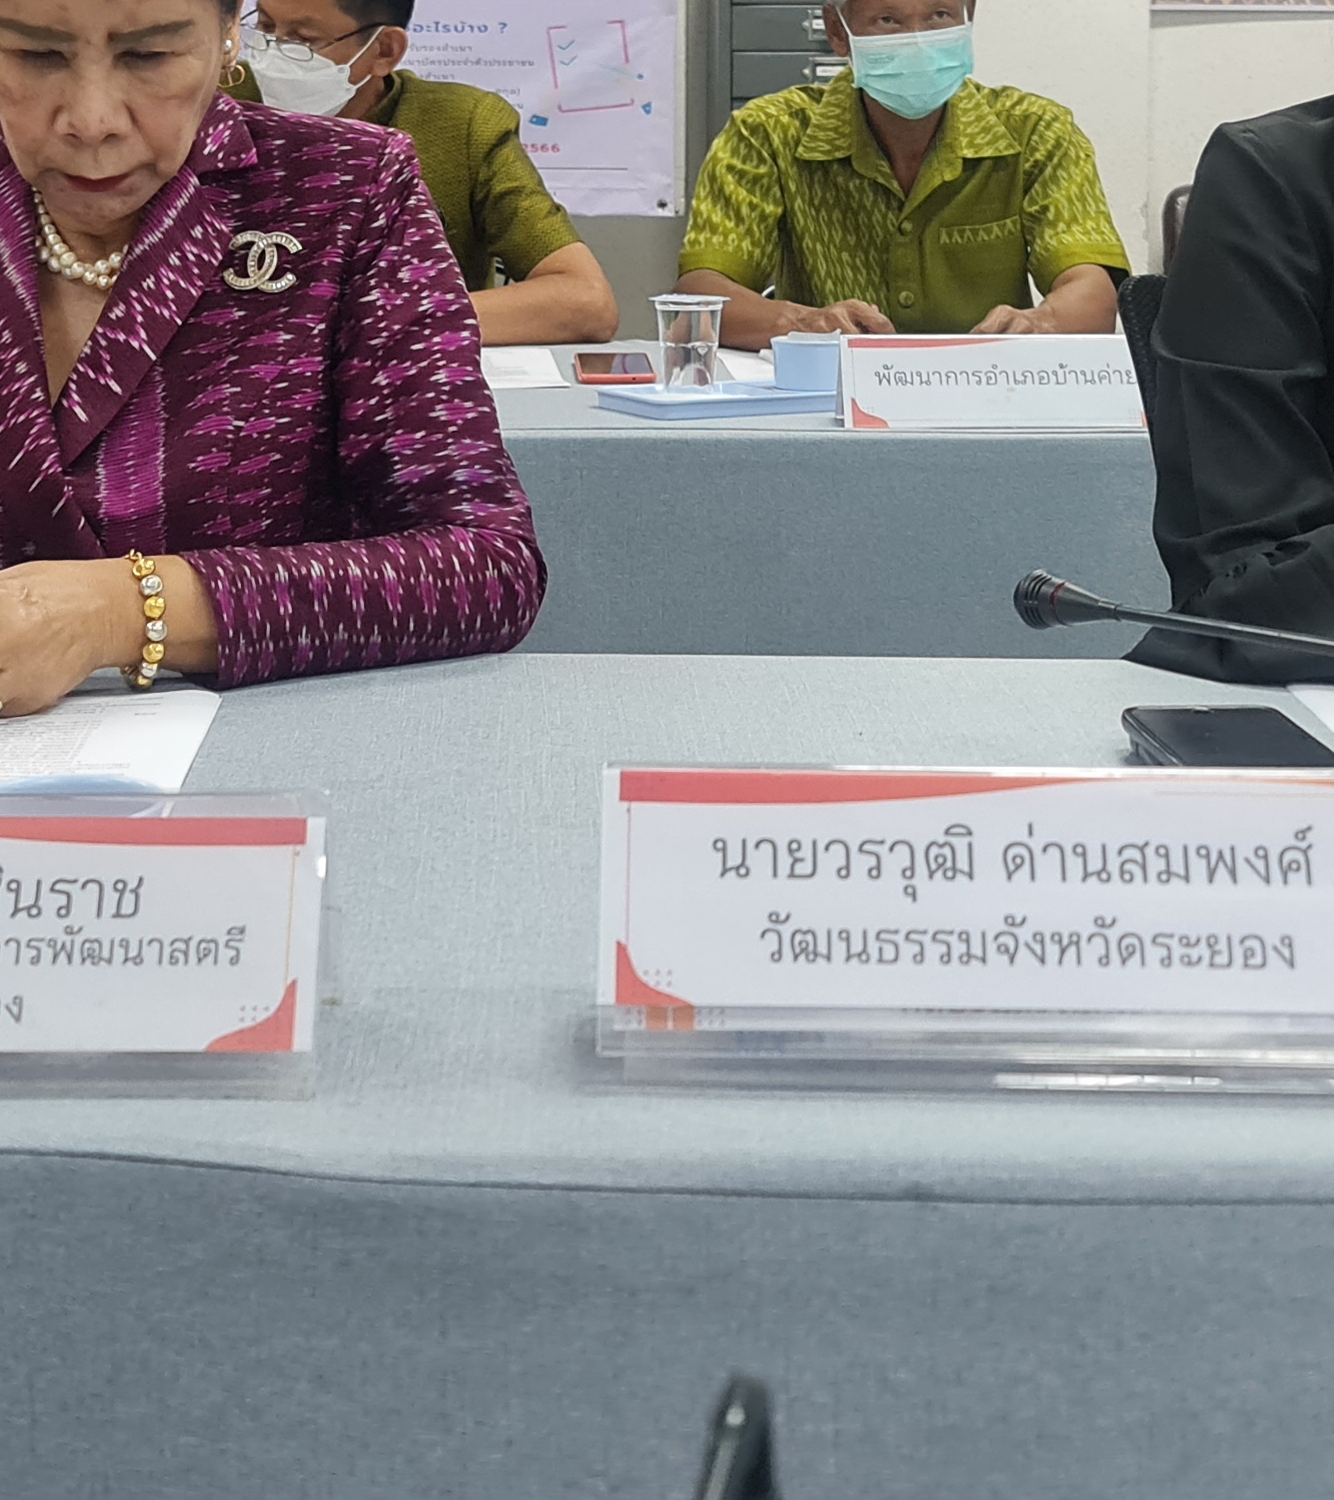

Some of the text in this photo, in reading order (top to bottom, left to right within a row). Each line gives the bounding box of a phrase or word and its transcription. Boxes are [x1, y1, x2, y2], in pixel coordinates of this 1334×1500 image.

[712, 824, 1316, 902] นายวรวุฒิ ด่านสมพงศ์
[758, 911, 1298, 972] วัฒนธรรมจังหวัดระยอง
